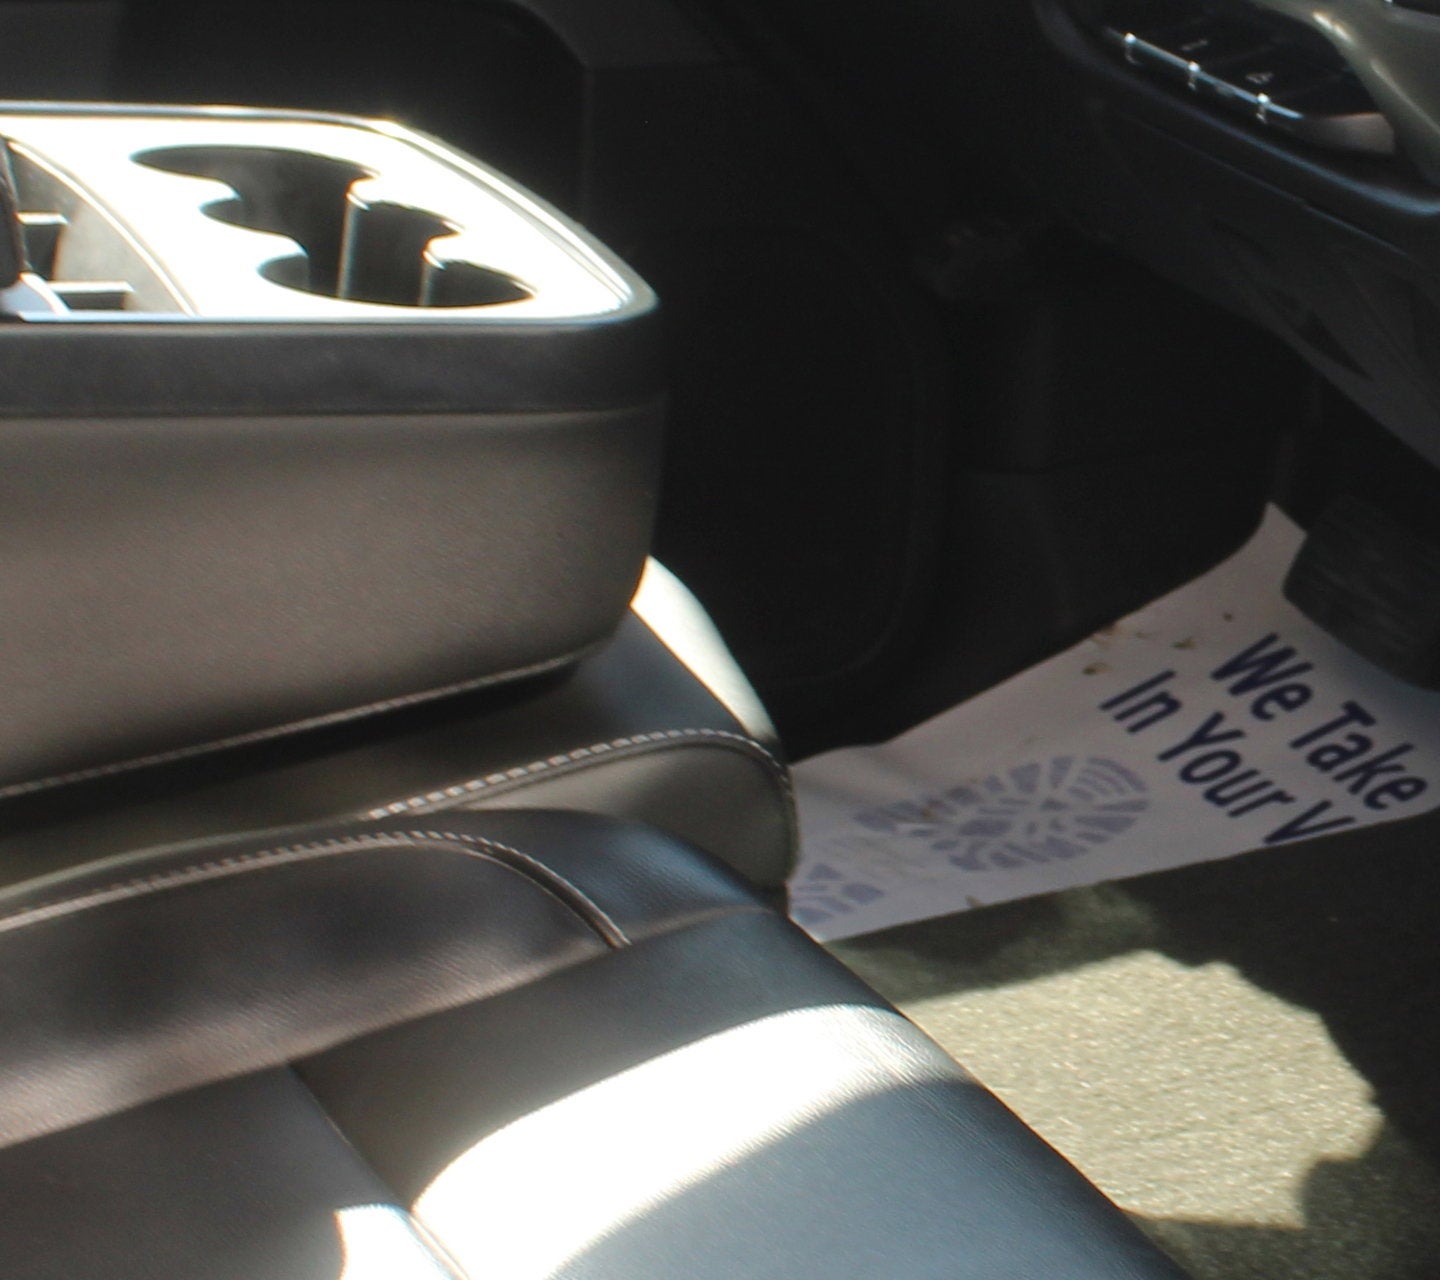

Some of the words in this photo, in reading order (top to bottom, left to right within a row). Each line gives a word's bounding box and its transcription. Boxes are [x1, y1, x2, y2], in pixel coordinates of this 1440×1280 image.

[1100, 670, 1181, 734] In
[1156, 712, 1296, 820] Your
[1211, 632, 1313, 721] We
[1290, 702, 1428, 811] Take
